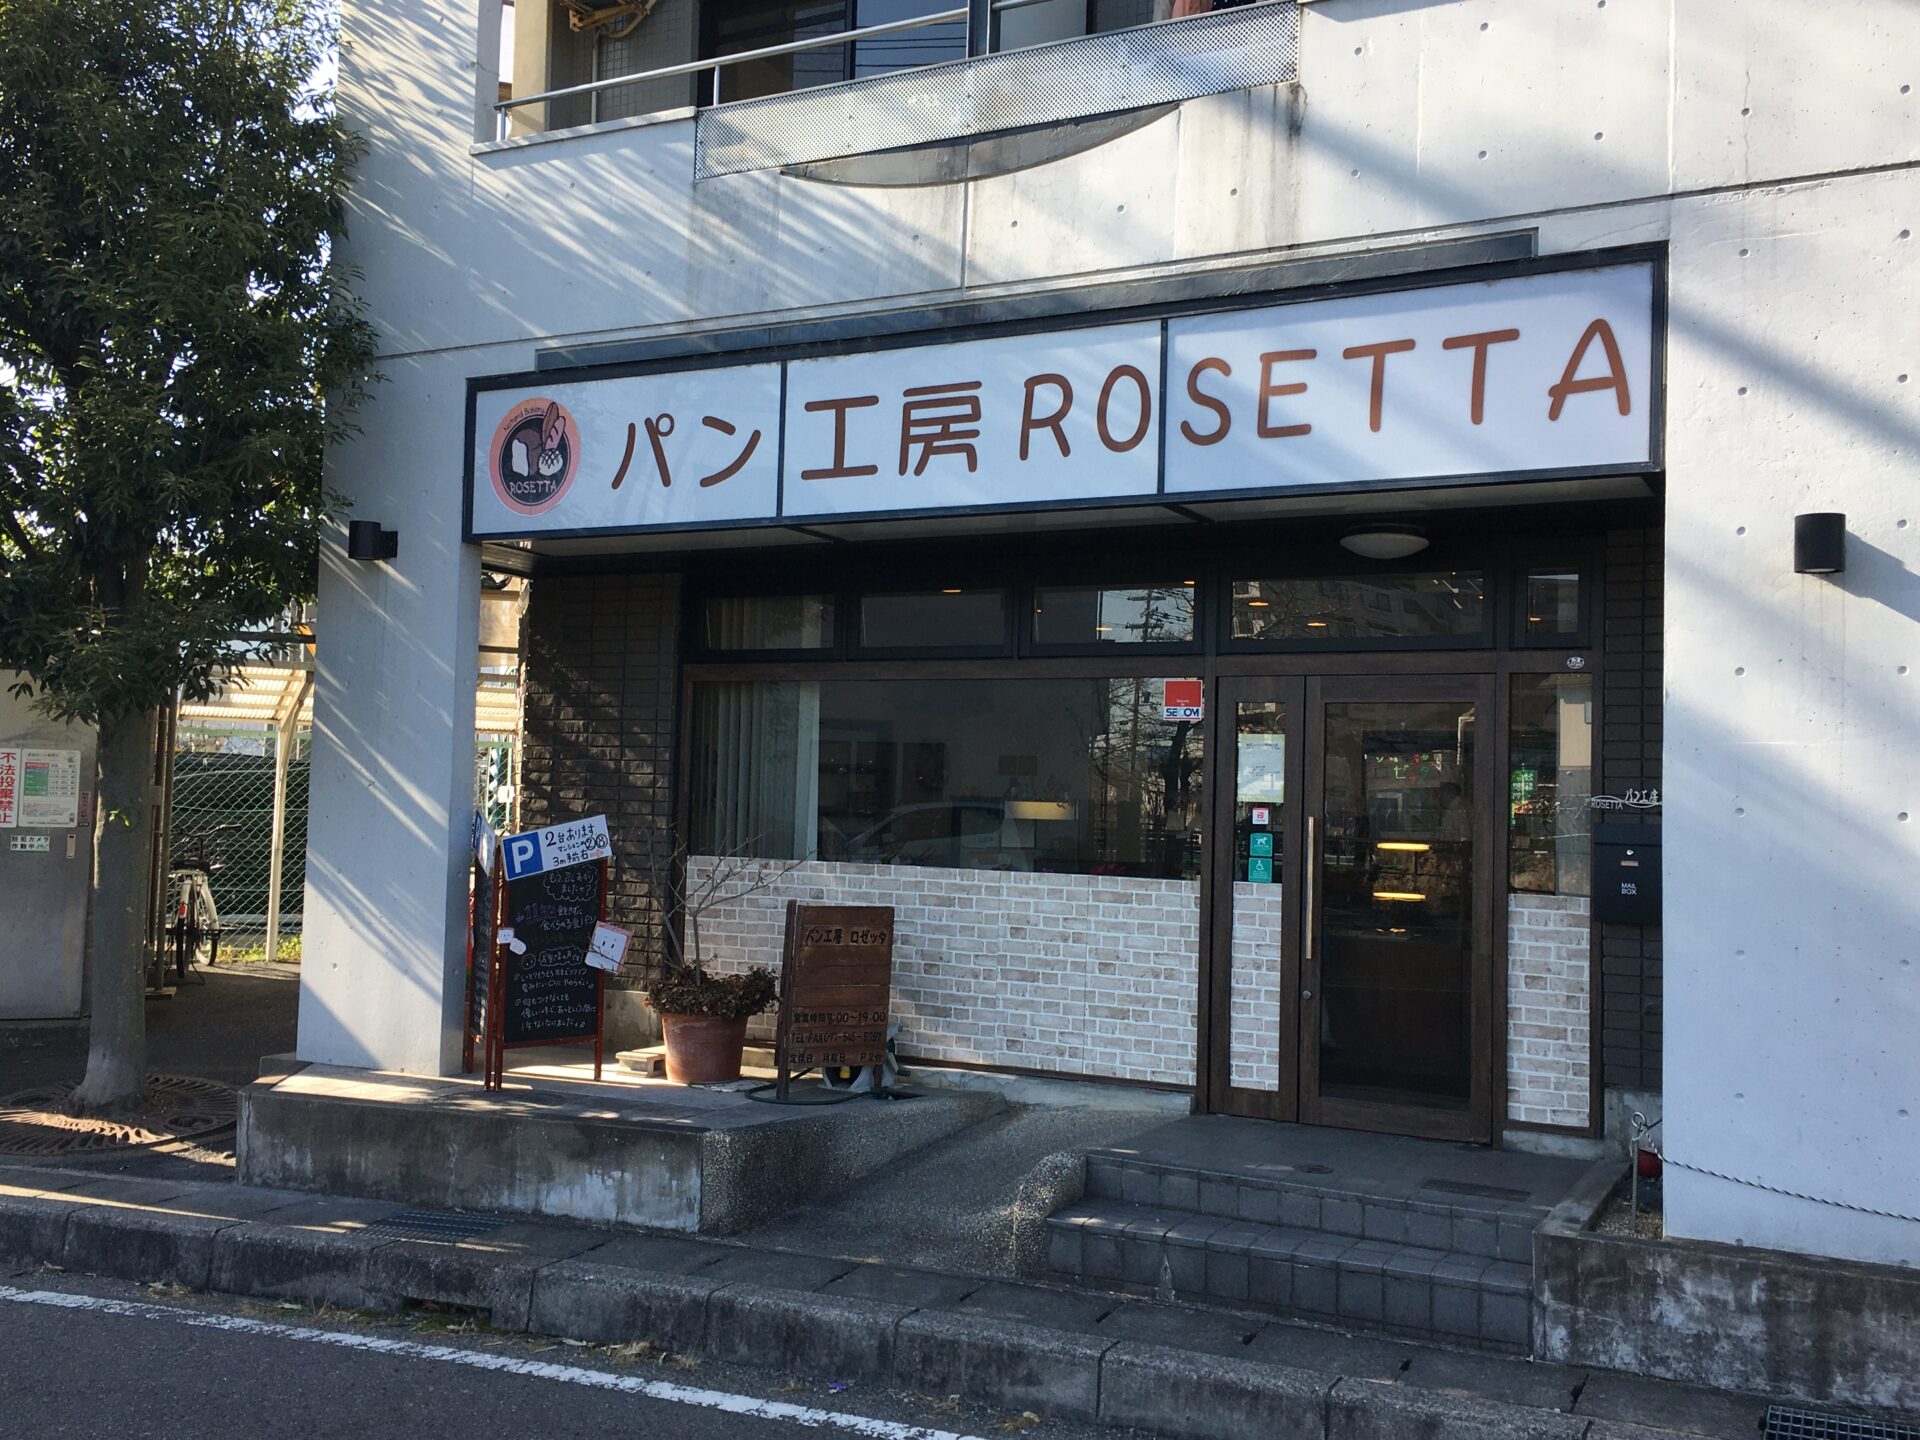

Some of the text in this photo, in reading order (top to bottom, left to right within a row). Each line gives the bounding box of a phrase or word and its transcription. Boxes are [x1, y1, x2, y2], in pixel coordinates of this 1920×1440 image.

[509, 480, 557, 495] ROSETTA
[1166, 708, 1200, 717] SEOM
[0, 751, 17, 824] 不法投棄禁止
[1591, 800, 1623, 810] ROSETTA
[511, 840, 534, 873] P
[805, 927, 887, 945] パン工房 ロゼッタ
